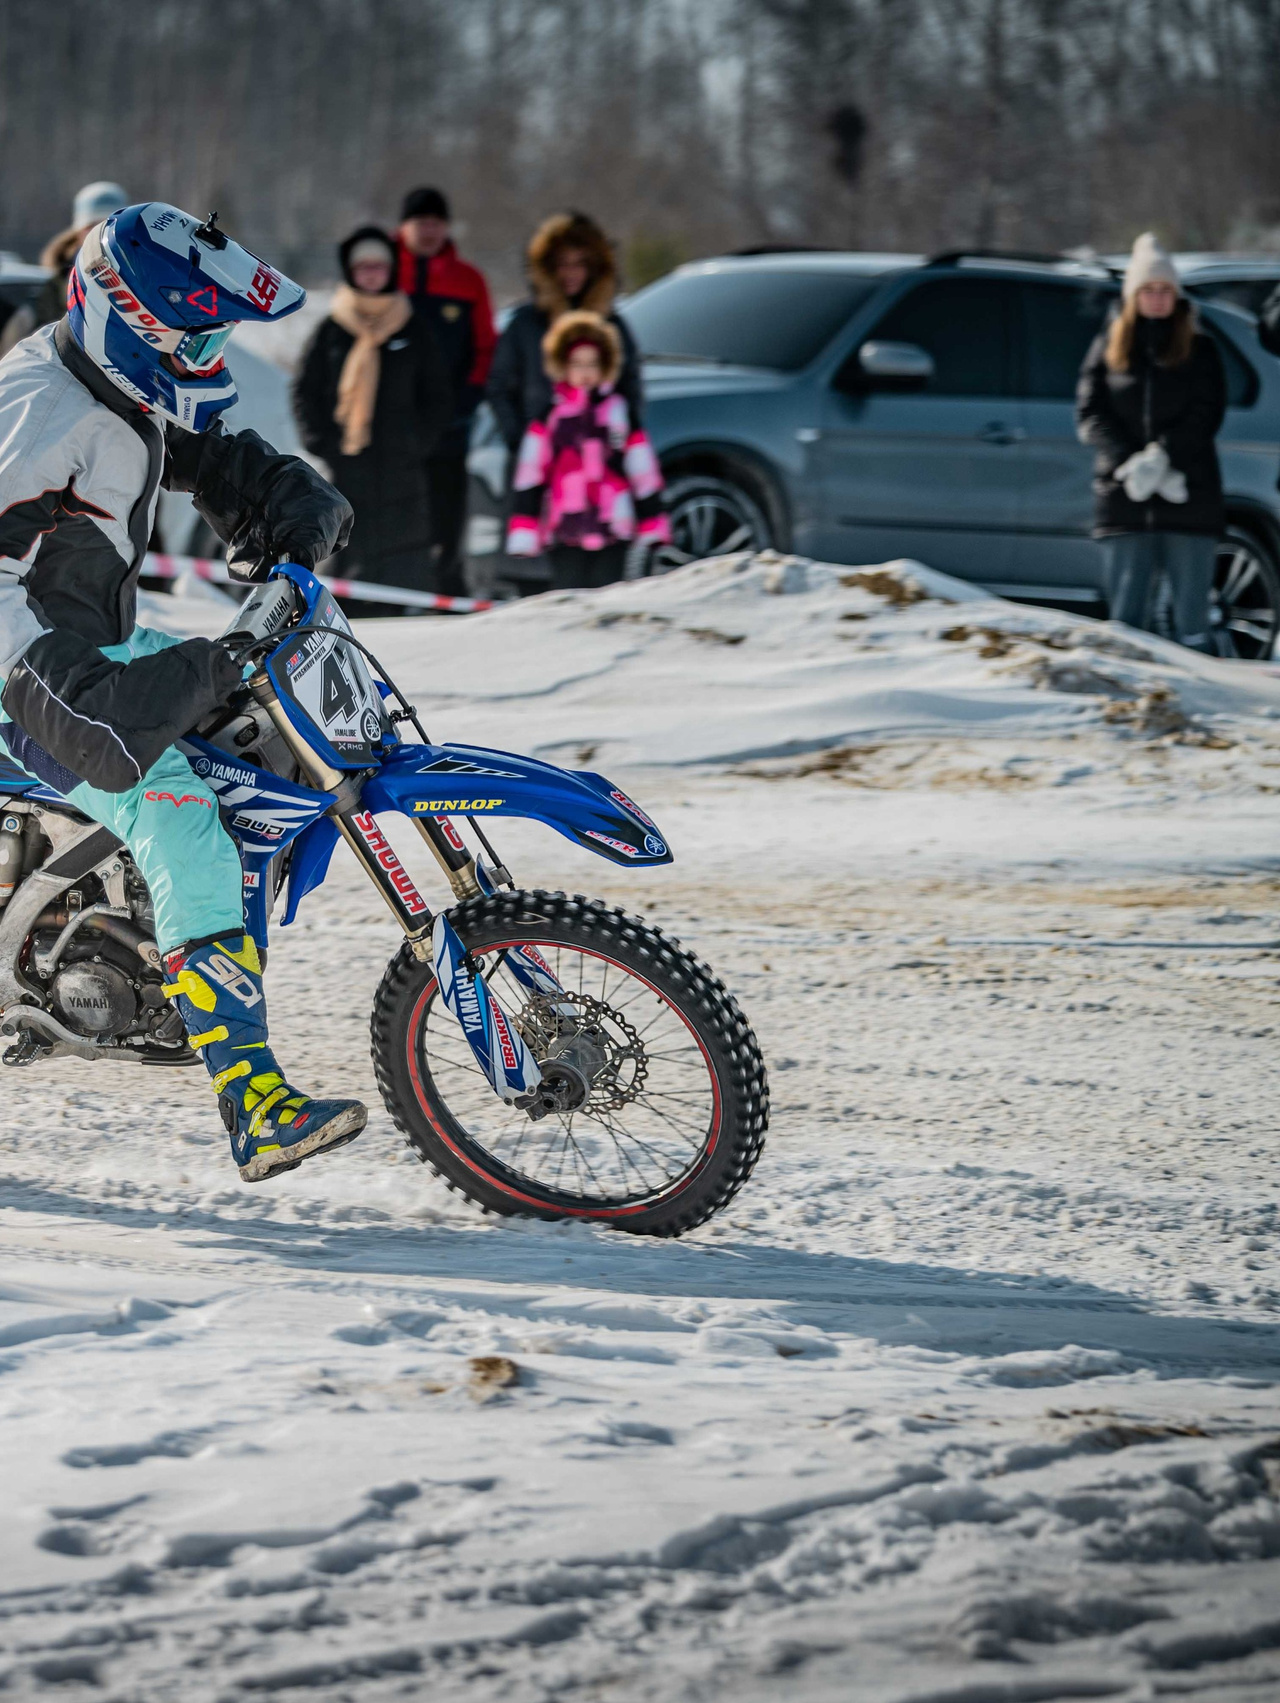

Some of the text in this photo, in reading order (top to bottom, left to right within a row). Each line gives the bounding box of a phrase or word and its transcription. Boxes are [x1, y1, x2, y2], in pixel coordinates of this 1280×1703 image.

[150, 210, 178, 232] MAHA
[91, 264, 171, 344] 00%
[262, 596, 290, 634] YAMAHA
[334, 729, 357, 737] YAMALUBE
[211, 762, 256, 787] YAMAHA
[413, 799, 503, 812] DUNLOP
[233, 814, 286, 836] BUD
[352, 810, 427, 916] SHOWA
[69, 996, 110, 1009] YAMAH
[455, 965, 482, 1033] YAMAHA
[489, 997, 517, 1068] BRAKING
